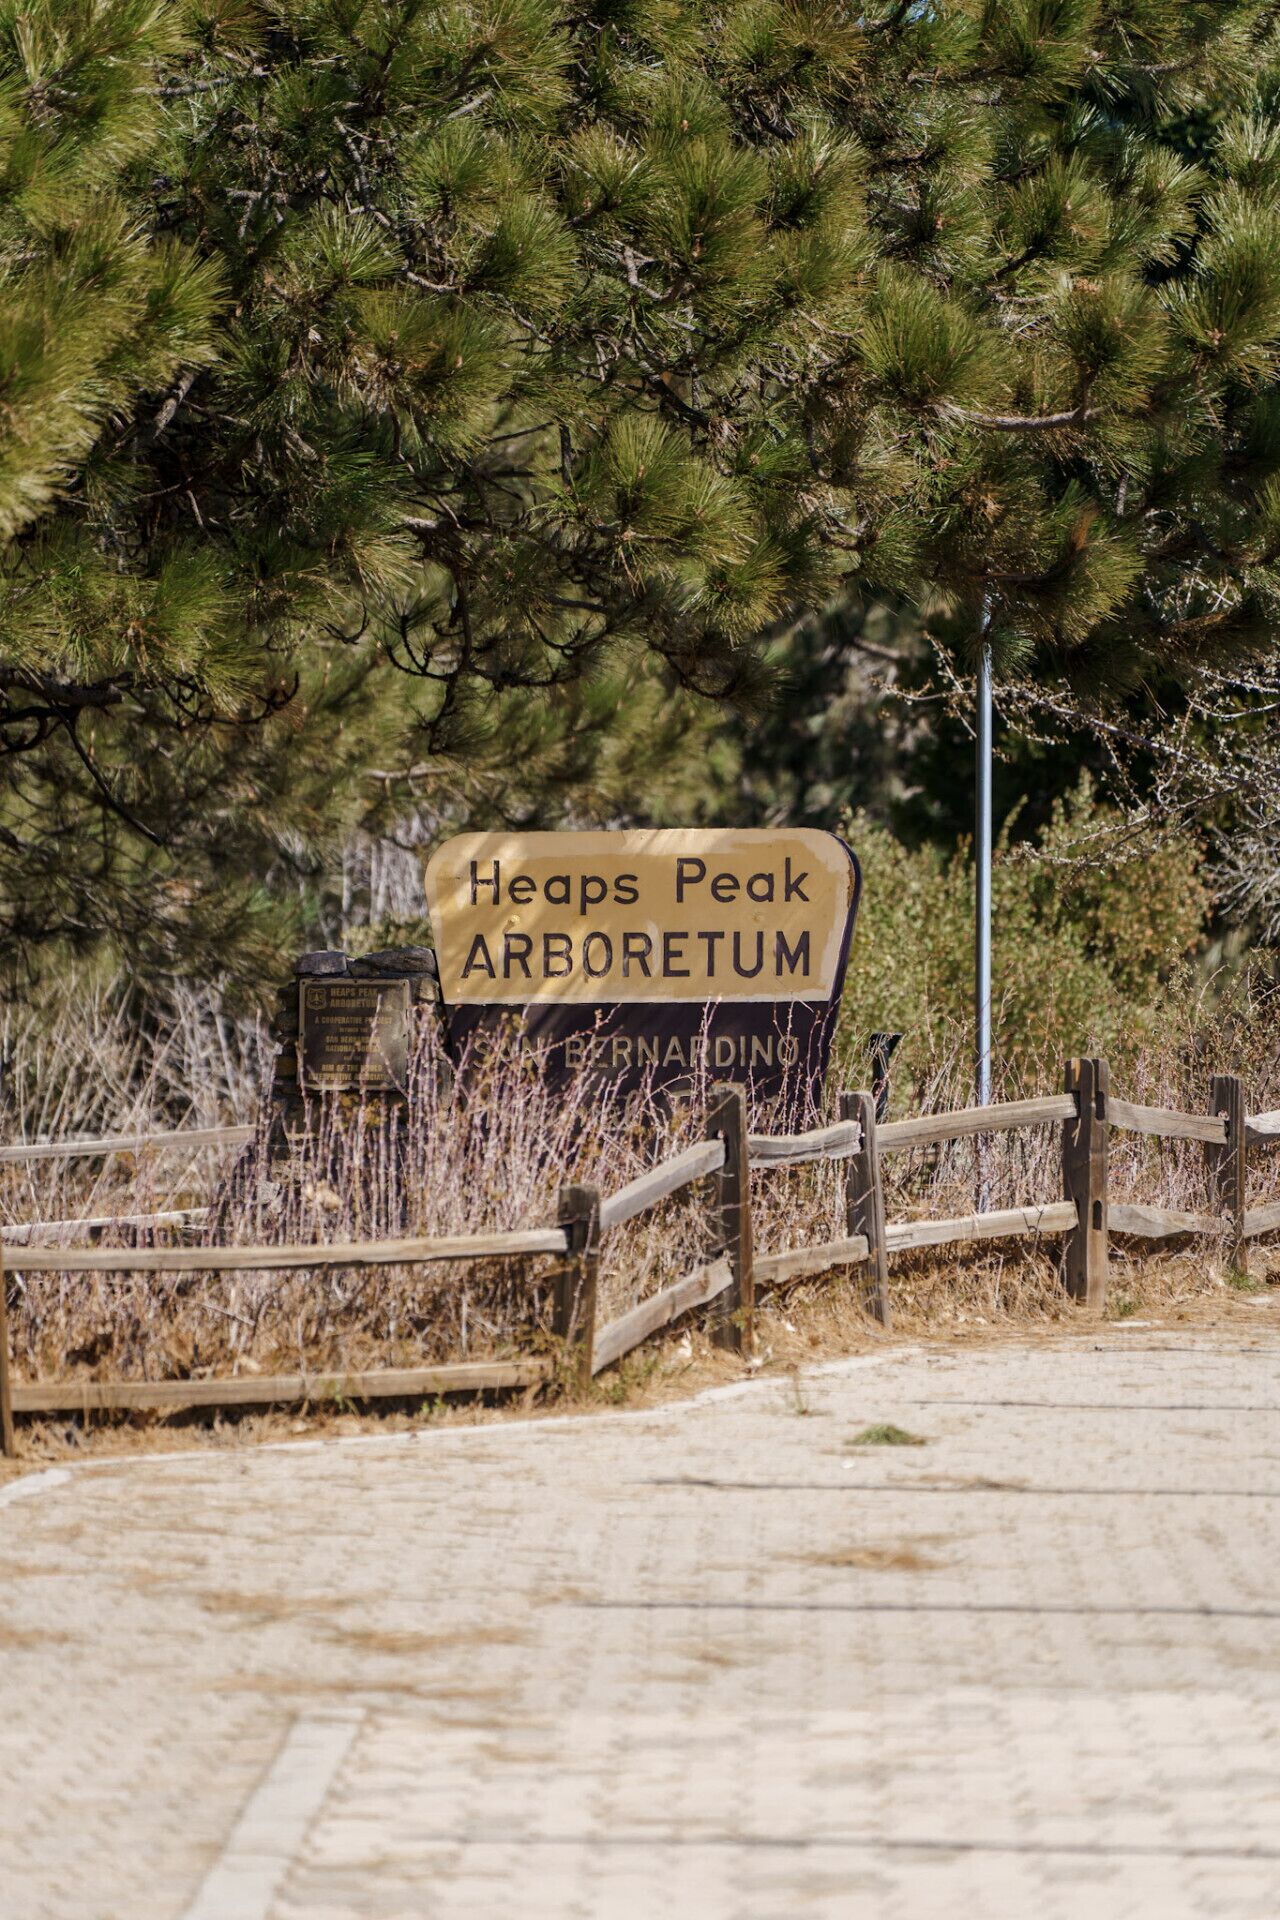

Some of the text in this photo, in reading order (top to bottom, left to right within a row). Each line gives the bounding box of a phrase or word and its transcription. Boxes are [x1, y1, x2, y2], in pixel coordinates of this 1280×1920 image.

[470, 856, 810, 916] Heaps Peak
[460, 930, 811, 979] ARBORETUM
[330, 988, 356, 997] HEAPS
[565, 1034, 800, 1068] BERNARDINO
